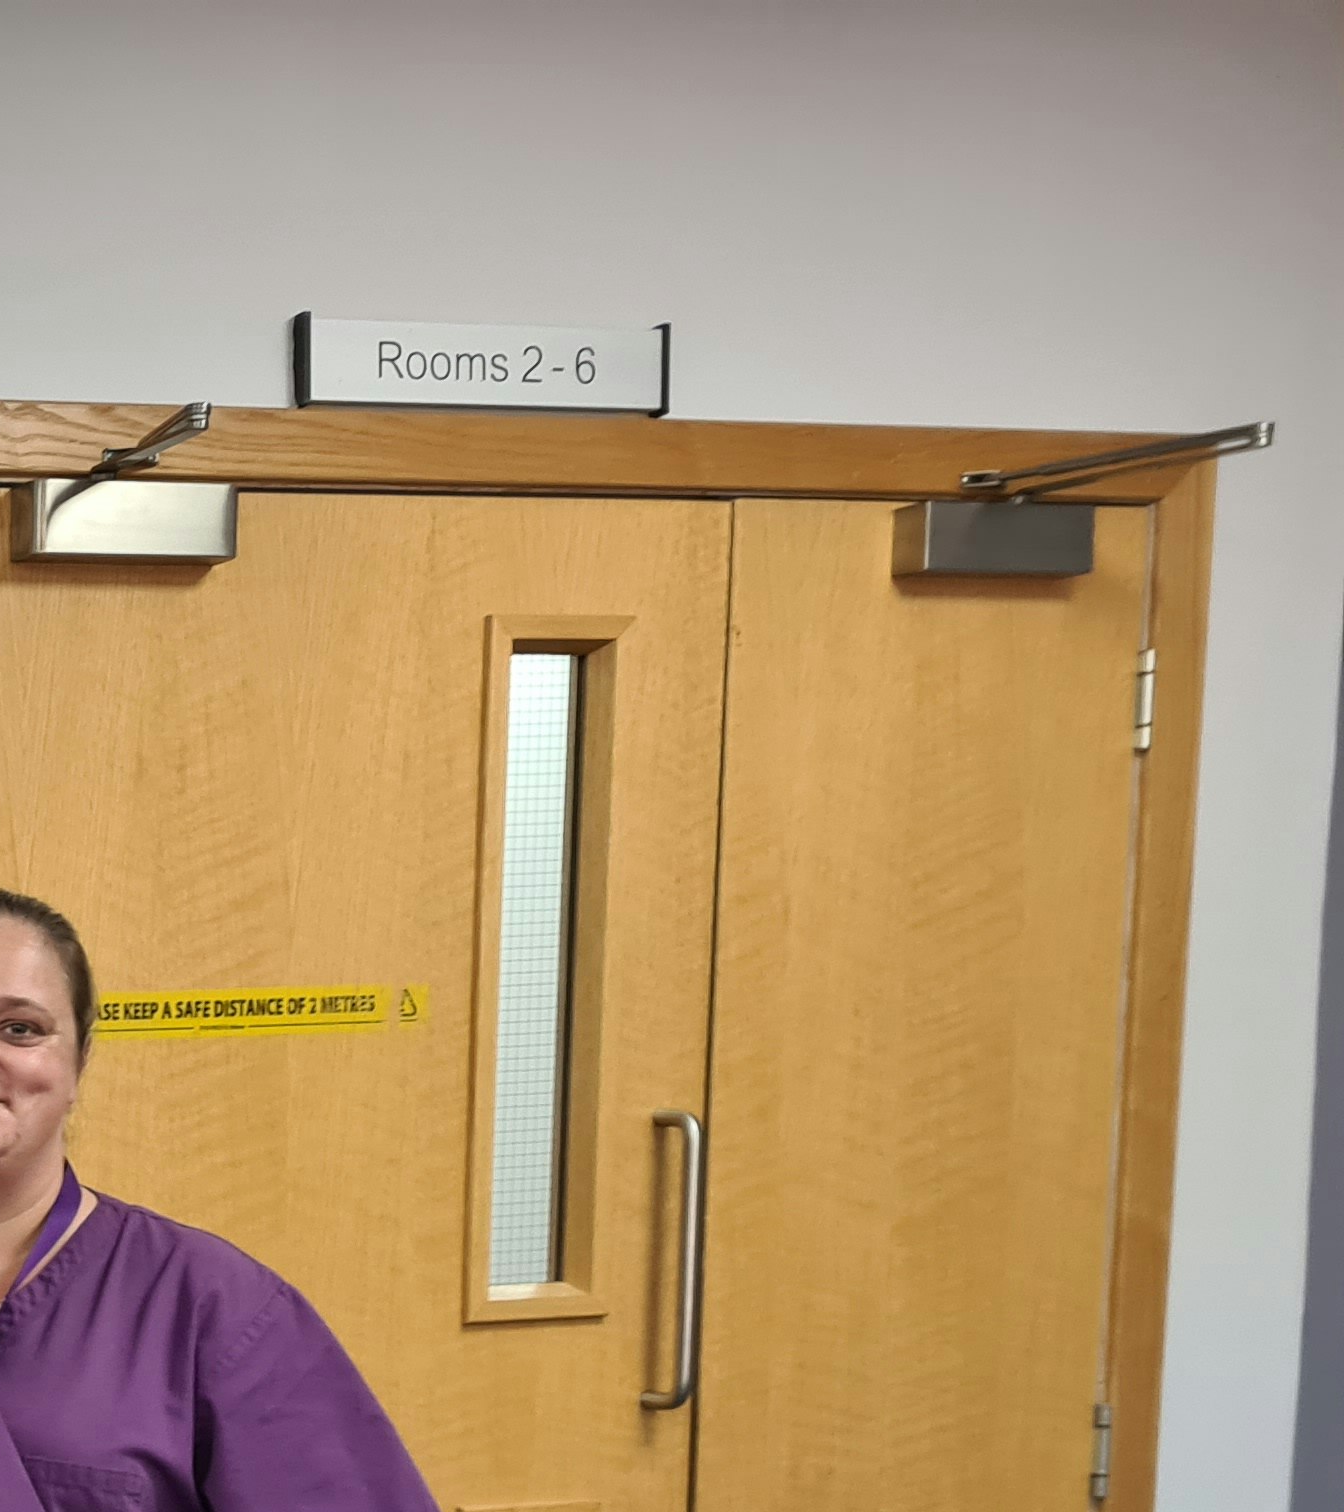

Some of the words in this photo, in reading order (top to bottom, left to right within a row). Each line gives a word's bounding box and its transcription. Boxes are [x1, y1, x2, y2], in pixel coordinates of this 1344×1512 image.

[379, 341, 508, 382] Rooms
[522, 346, 542, 382] 2
[576, 347, 595, 384] 6
[124, 1002, 158, 1020] KEEP
[161, 1002, 172, 1019] A
[176, 1001, 210, 1018] SAFE
[214, 998, 283, 1017] DISTANCE
[287, 998, 306, 1014] OF
[309, 998, 317, 1014] 2
[320, 995, 375, 1013] METRES
